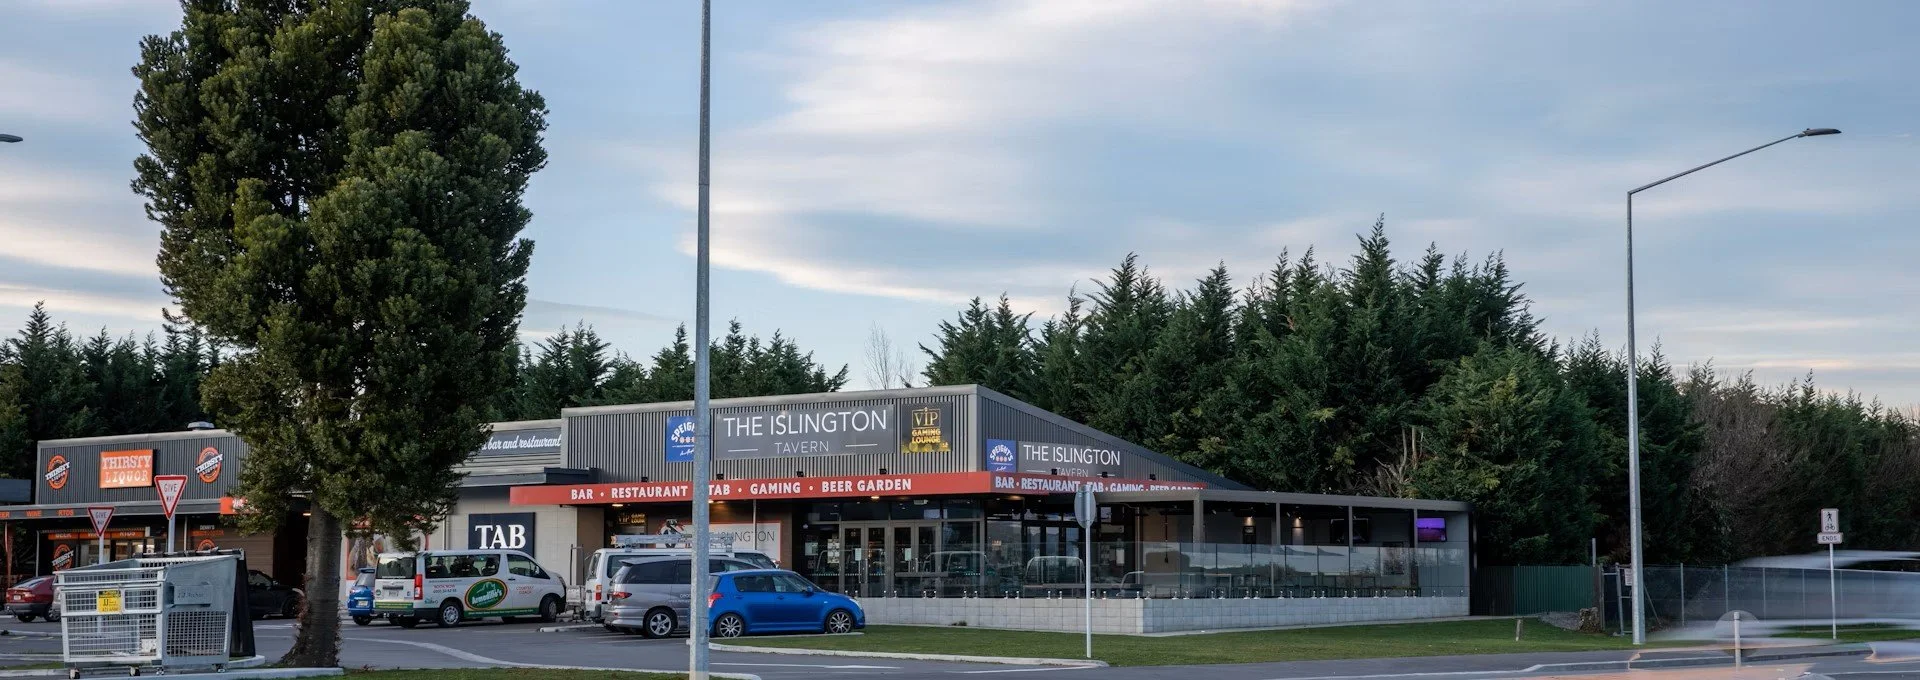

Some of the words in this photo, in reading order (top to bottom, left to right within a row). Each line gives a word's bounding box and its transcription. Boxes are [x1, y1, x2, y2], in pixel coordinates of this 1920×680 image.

[723, 415, 763, 437] THE
[770, 410, 886, 436] ISLINGTON
[914, 407, 938, 426] VIP
[488, 437, 501, 449] bar
[502, 435, 519, 449] and
[518, 434, 562, 448] restaurant
[774, 440, 829, 454] TAVERN
[990, 444, 1014, 461] SPEIGHT'S
[1023, 445, 1049, 461] THE
[1053, 447, 1121, 466] ISLINGTON
[45, 461, 71, 481] THIRSTY
[102, 455, 152, 470] THIRSTY
[196, 453, 223, 474] THIRSTY
[105, 470, 148, 485] LIQUOR
[1056, 467, 1089, 477] TAVERN
[164, 483, 178, 492] GIVE
[571, 488, 594, 500] BAR
[611, 485, 688, 499] RESTAURANT
[708, 484, 730, 495] TAB
[750, 482, 801, 495] GAMING
[821, 480, 852, 493] BEER
[857, 479, 912, 491] GARDEN
[995, 476, 1014, 489] BAR
[1021, 478, 1081, 493] RESTAURANT
[1087, 481, 1104, 493] TAB
[1110, 483, 1144, 492] GAMING
[474, 524, 526, 549] TAB
